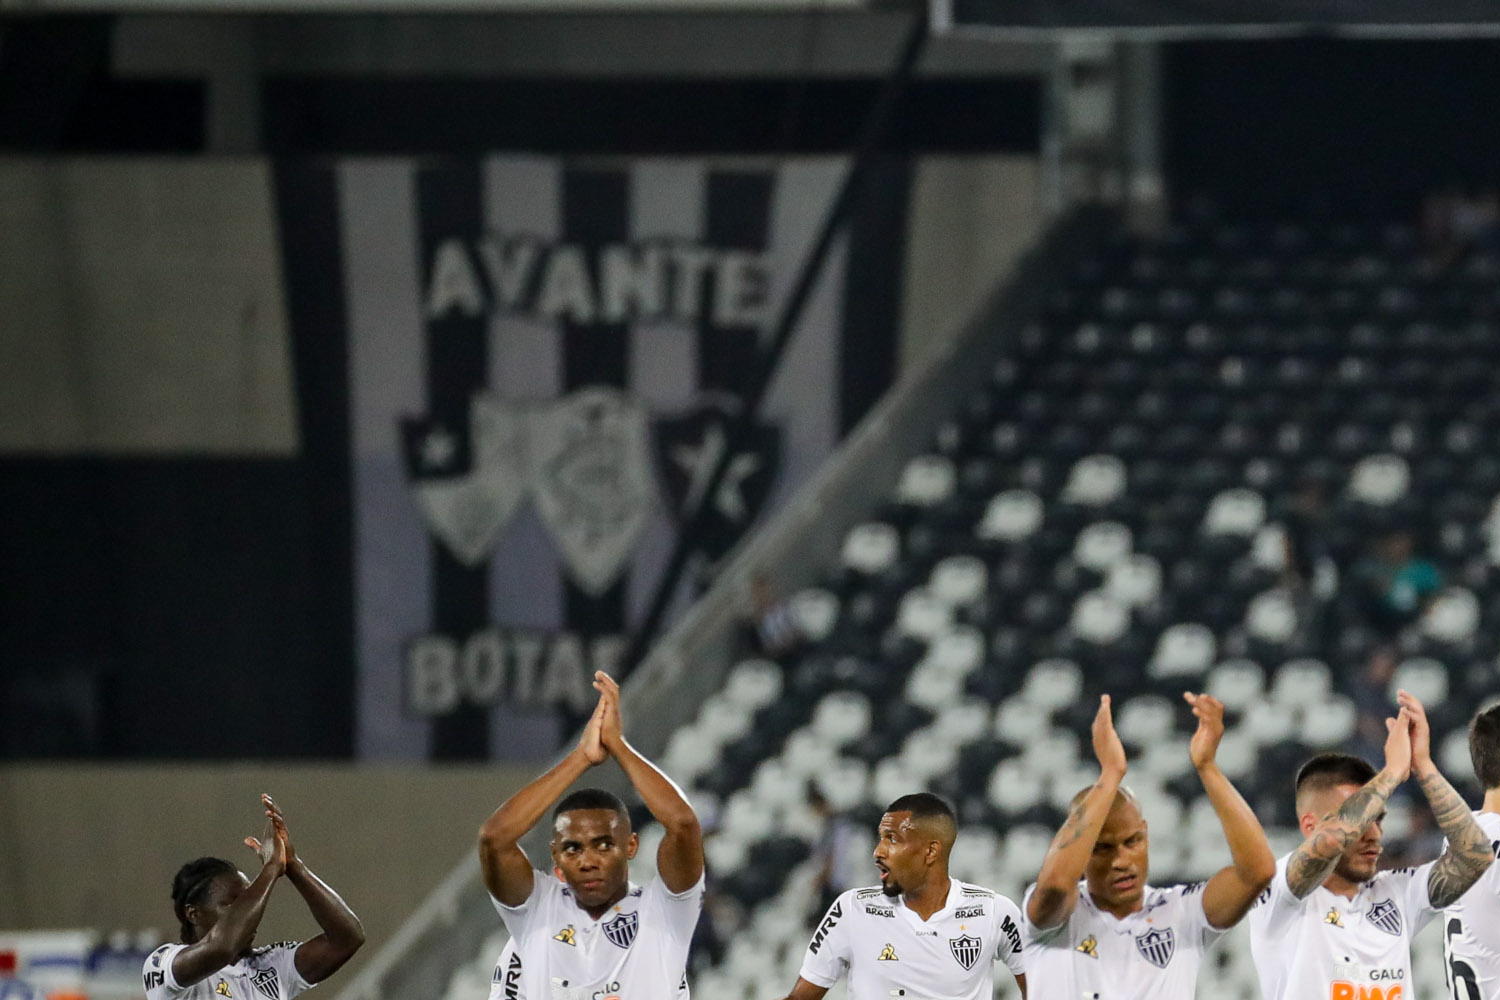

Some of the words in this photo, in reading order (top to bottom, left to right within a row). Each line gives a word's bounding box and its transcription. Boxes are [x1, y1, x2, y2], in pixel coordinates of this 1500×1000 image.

[428, 237, 772, 325] AVANTE
[865, 907, 896, 919] BRASIL
[955, 908, 986, 919] BRASIL
[809, 901, 843, 955] MRV
[1000, 914, 1023, 954] MRV
[954, 940, 978, 949] CAM
[1369, 968, 1405, 981] GALO
